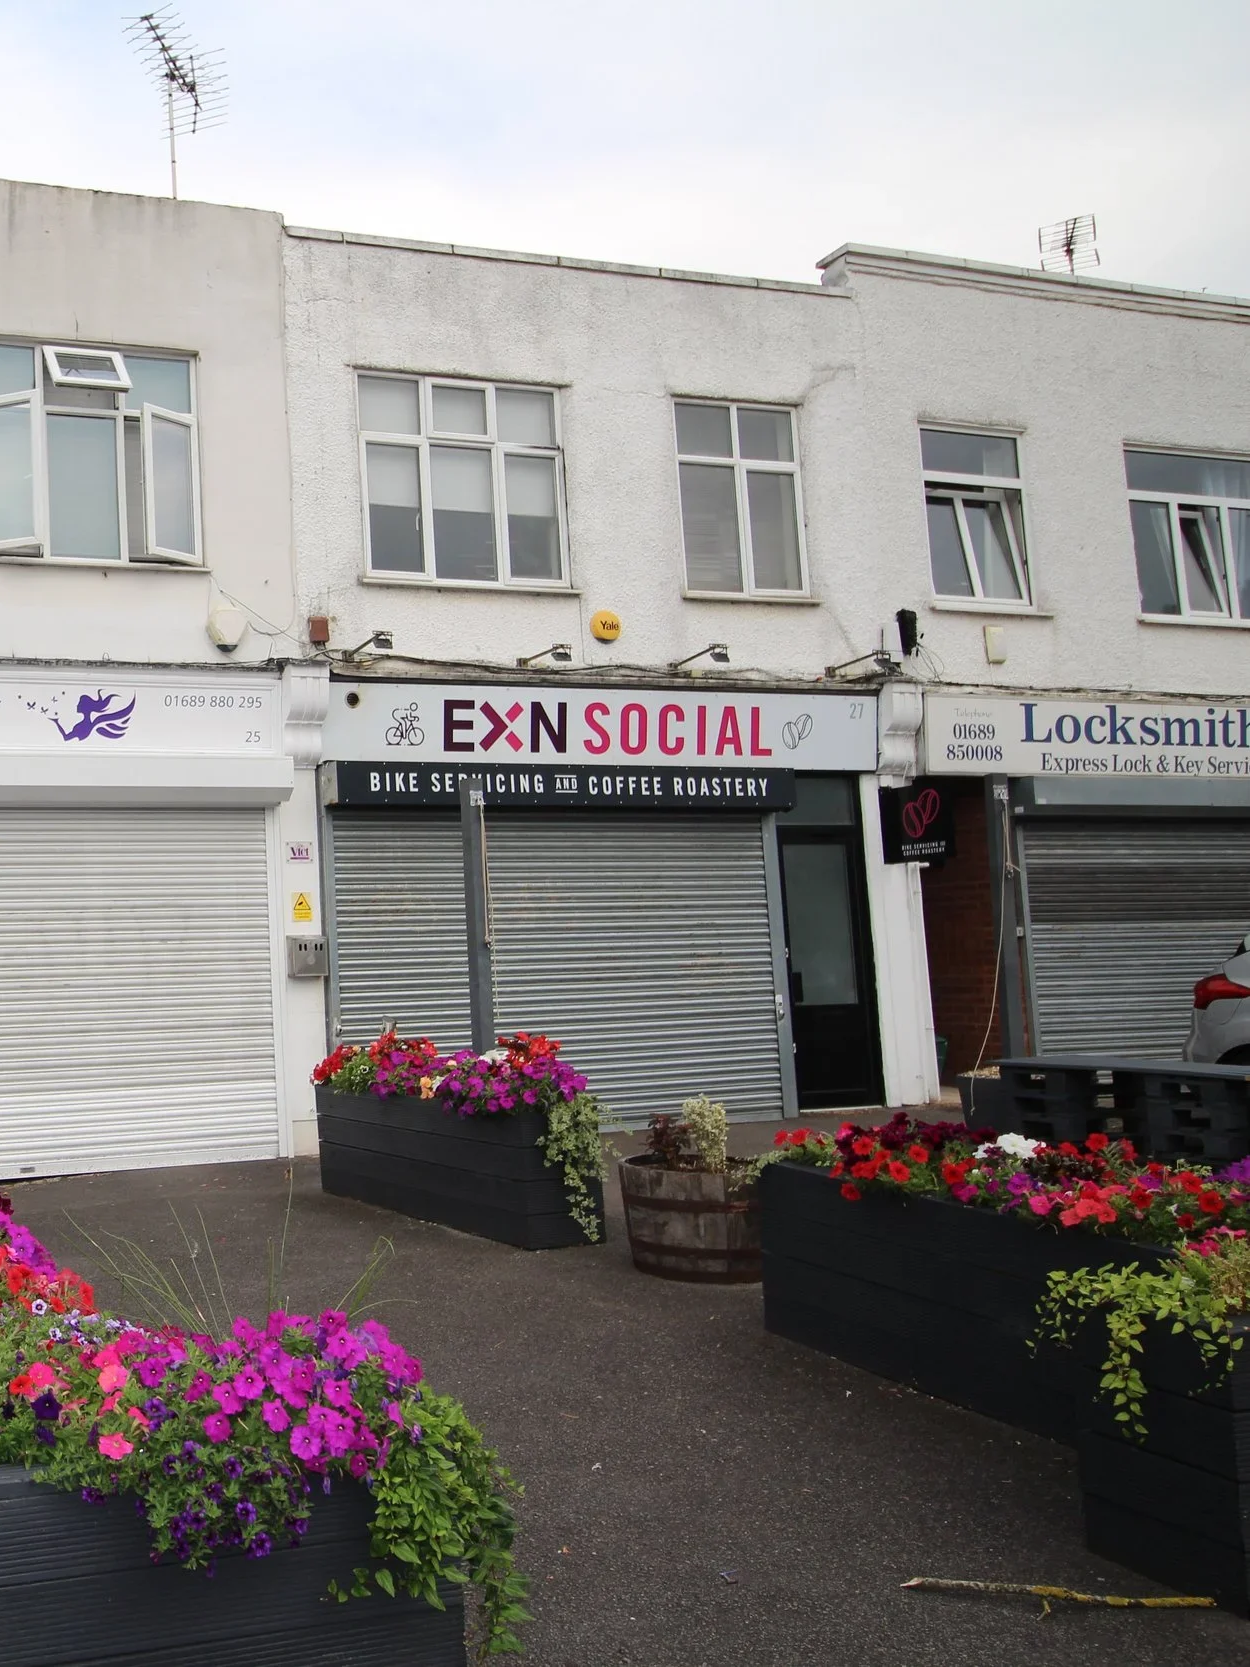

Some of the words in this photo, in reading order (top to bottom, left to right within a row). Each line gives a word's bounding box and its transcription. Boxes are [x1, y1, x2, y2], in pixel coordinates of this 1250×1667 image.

[600, 620, 619, 631] Yale
[164, 694, 206, 708] 01689
[209, 695, 235, 709] 880
[238, 695, 263, 709] 295
[849, 702, 864, 720] 27
[245, 730, 261, 744] 25
[583, 702, 773, 756] SOCIAL
[953, 723, 996, 740] 01689
[946, 744, 1003, 761] 850008
[1041, 753, 1108, 775] Express
[1112, 754, 1152, 774] Lock
[1156, 756, 1170, 773] &
[1173, 756, 1203, 776] Key
[1207, 756, 1250, 775] Servi
[370, 771, 419, 793] BIKE
[431, 773, 545, 794] SEICING
[555, 777, 578, 790] AND
[588, 776, 662, 796] COFFEE
[674, 777, 769, 798] ROASTERY
